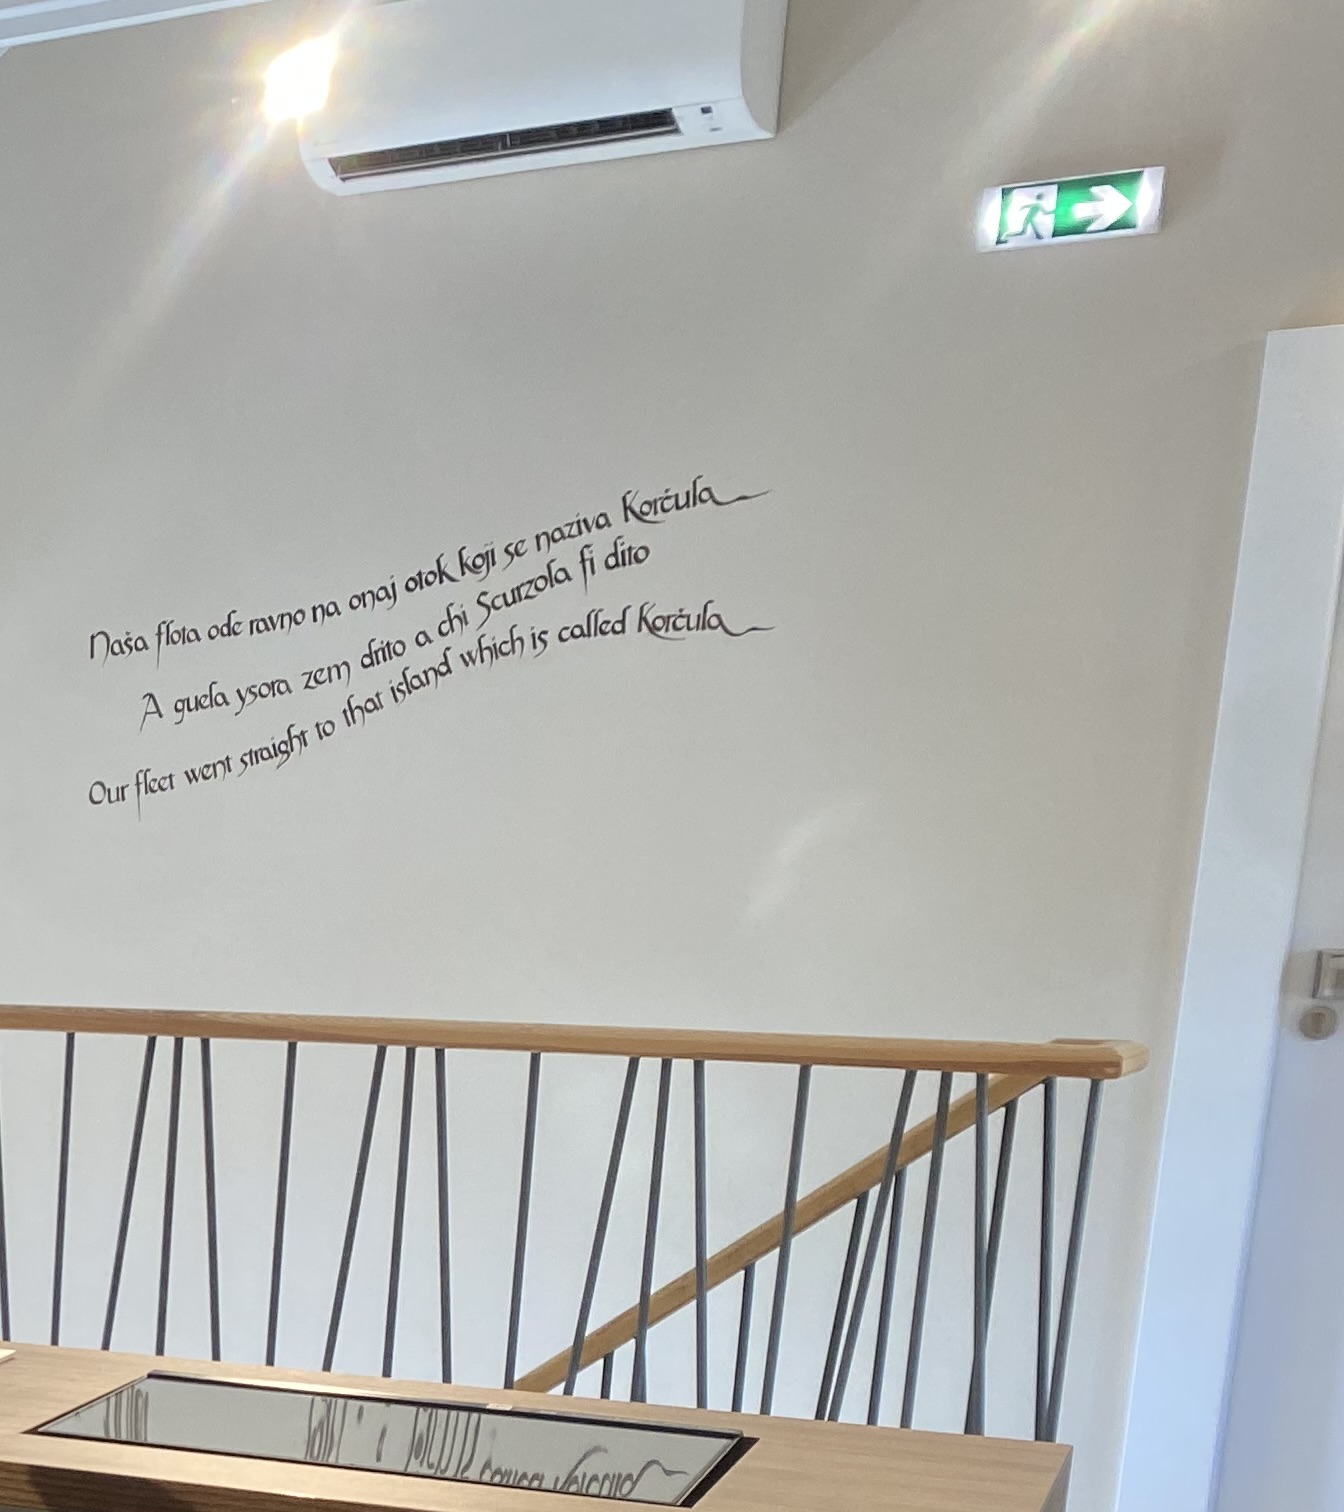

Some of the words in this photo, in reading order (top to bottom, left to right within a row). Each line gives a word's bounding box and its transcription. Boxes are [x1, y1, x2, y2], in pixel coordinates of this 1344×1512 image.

[90, 630, 149, 668] Naša
[156, 620, 202, 669] flota
[207, 610, 242, 640] ode
[249, 608, 306, 636] ravno
[311, 600, 341, 626] na
[348, 575, 397, 611] onaj
[404, 553, 460, 593] otok
[458, 541, 497, 583] koji
[502, 539, 528, 571] se
[535, 511, 613, 552] naziva
[621, 474, 772, 525] Korčula
[139, 692, 163, 732] A
[234, 678, 293, 716] ysora
[301, 661, 351, 689] zem
[414, 630, 434, 648] a
[437, 602, 470, 636] chi
[476, 558, 572, 631] Scurzola
[578, 543, 597, 595] fi
[604, 535, 651, 571] dito
[89, 780, 130, 805] Our
[135, 768, 175, 821] fleet
[184, 755, 233, 782] went
[238, 723, 308, 776] straight
[314, 719, 335, 740] to
[342, 694, 385, 728] that
[390, 646, 453, 705] island
[459, 624, 525, 669] which
[531, 626, 550, 658] is
[557, 604, 633, 643] called
[637, 599, 776, 641] Korčula
